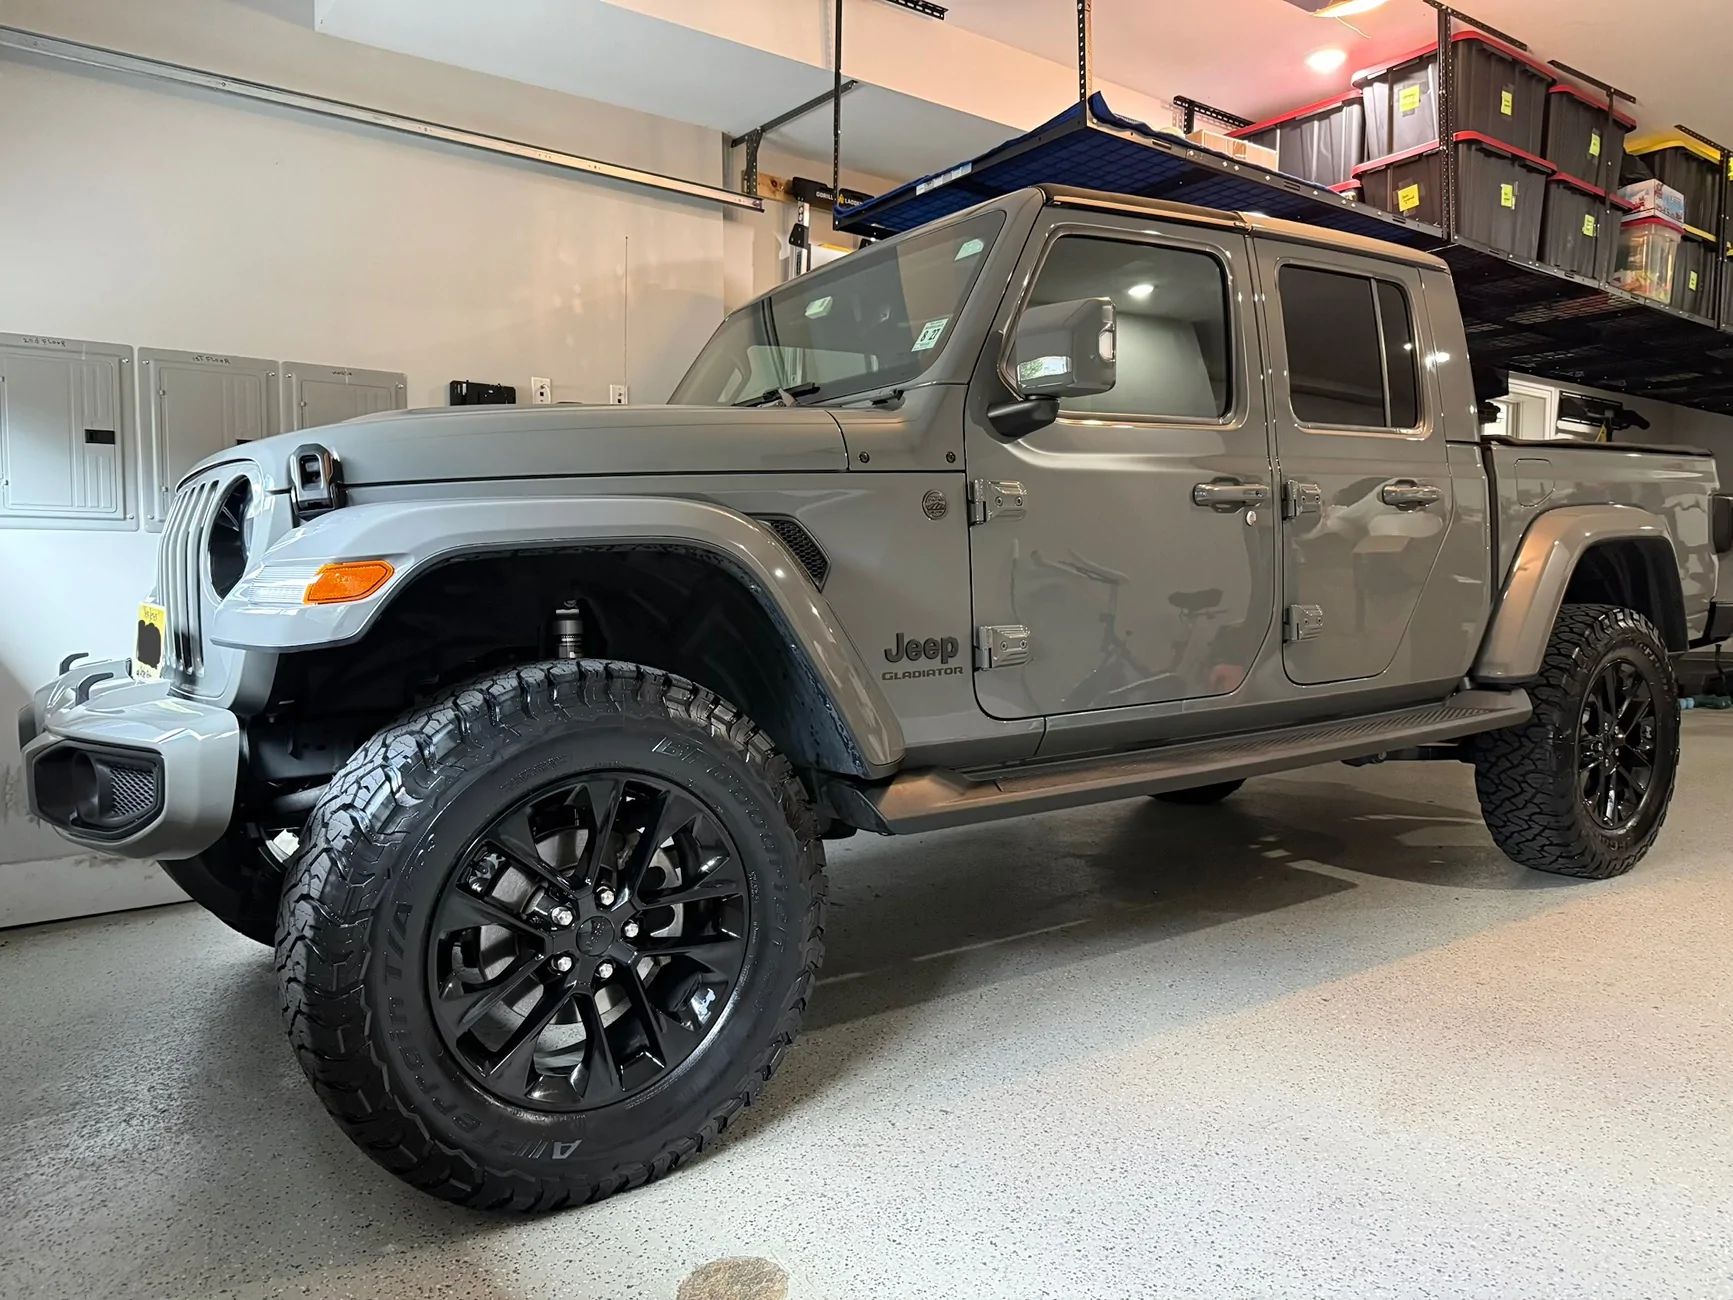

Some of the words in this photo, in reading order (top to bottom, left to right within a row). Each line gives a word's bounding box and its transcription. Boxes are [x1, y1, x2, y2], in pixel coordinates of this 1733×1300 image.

[816, 191, 834, 201] GORILL
[884, 632, 959, 664] Jeep
[881, 666, 963, 681] GLADIATOR
